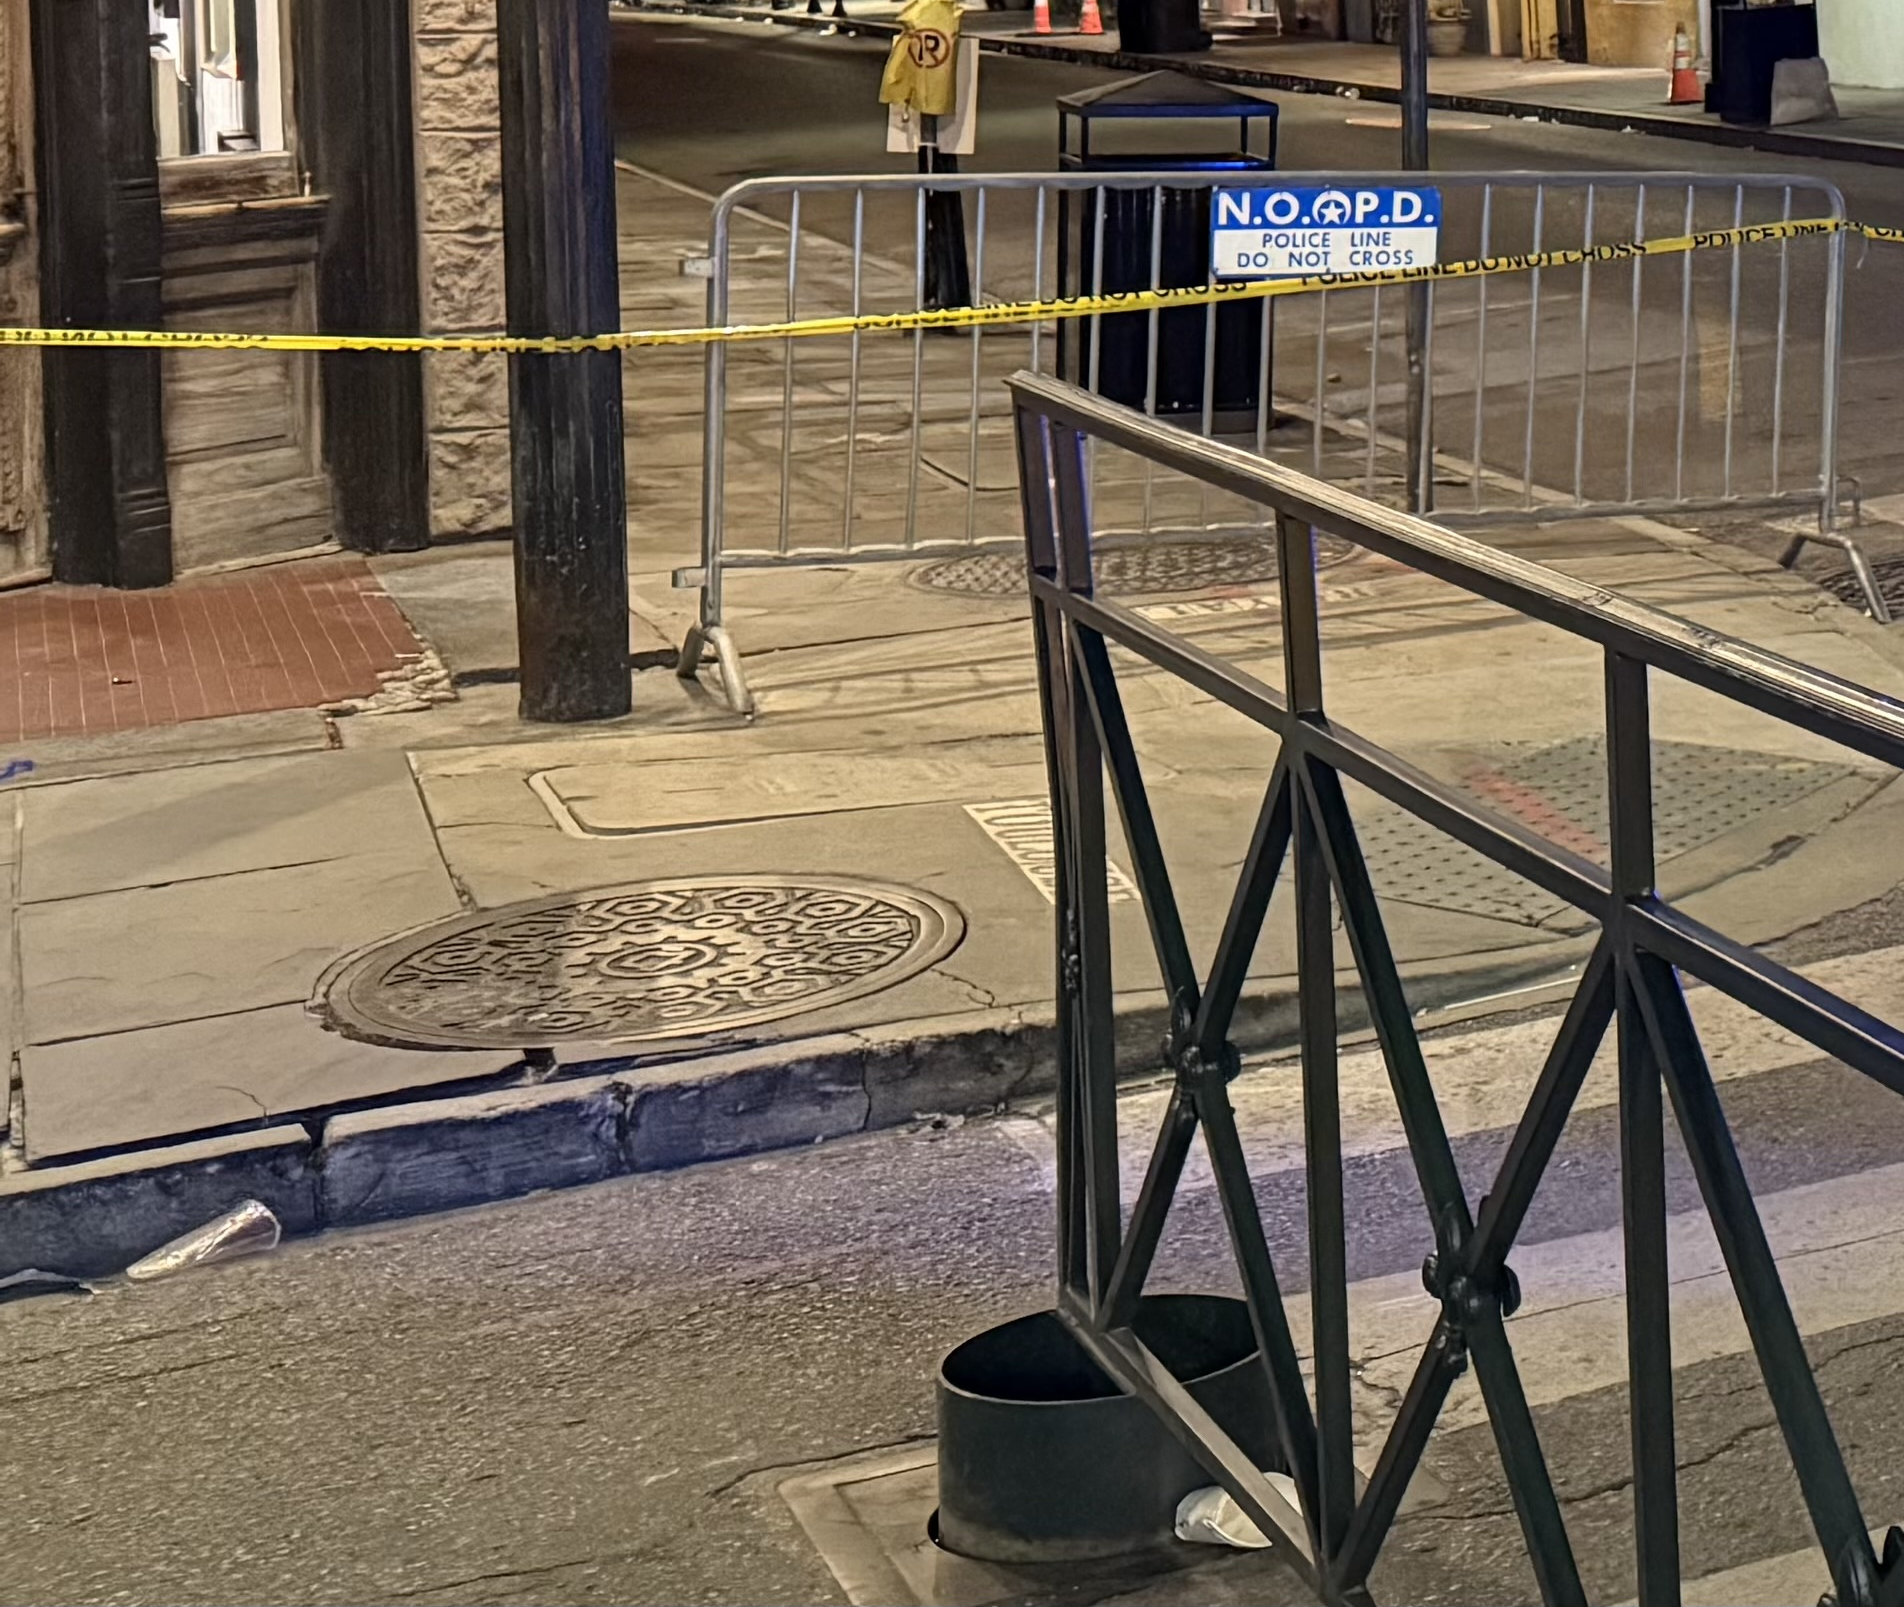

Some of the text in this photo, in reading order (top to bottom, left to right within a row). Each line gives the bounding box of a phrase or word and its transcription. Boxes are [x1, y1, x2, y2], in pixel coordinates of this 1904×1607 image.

[1262, 231, 1392, 249] POLICE LINE
[1237, 249, 1415, 268] DO NOT CROSS
